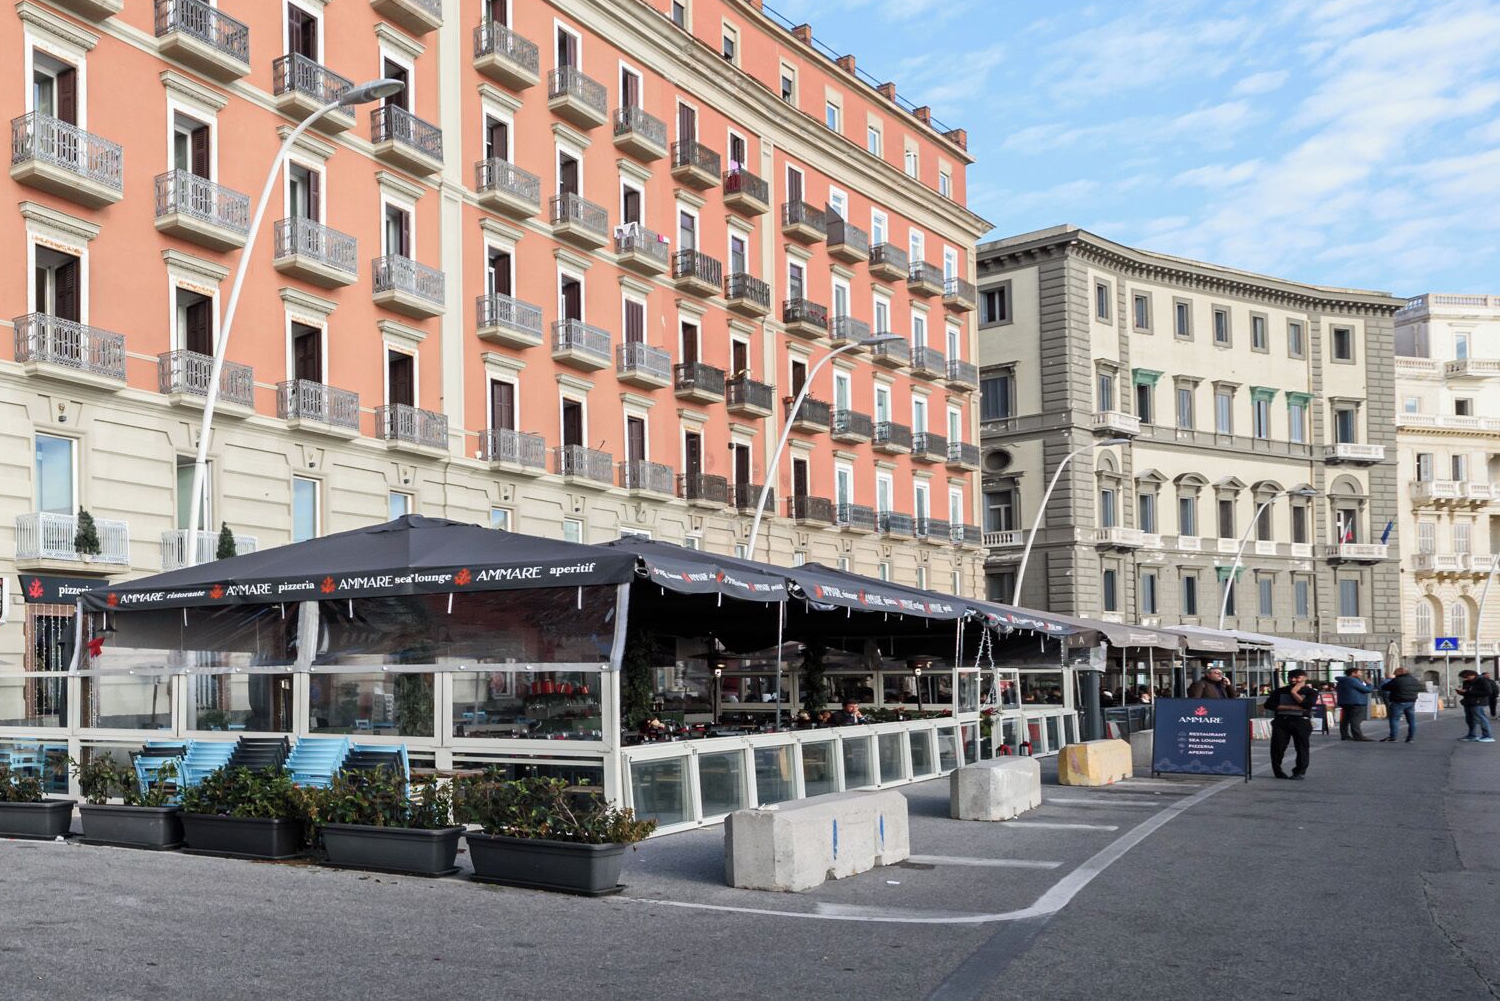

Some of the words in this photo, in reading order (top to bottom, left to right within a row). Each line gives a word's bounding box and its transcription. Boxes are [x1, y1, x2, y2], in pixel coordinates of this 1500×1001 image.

[120, 591, 165, 604] AMMARE
[166, 590, 205, 599] ristorante
[225, 583, 273, 597] AMMARE
[278, 581, 315, 593] pizzeria
[338, 575, 394, 590] AMMARE
[414, 573, 452, 584] lounge
[476, 566, 542, 582] AMMARE
[550, 562, 596, 576] aperitif
